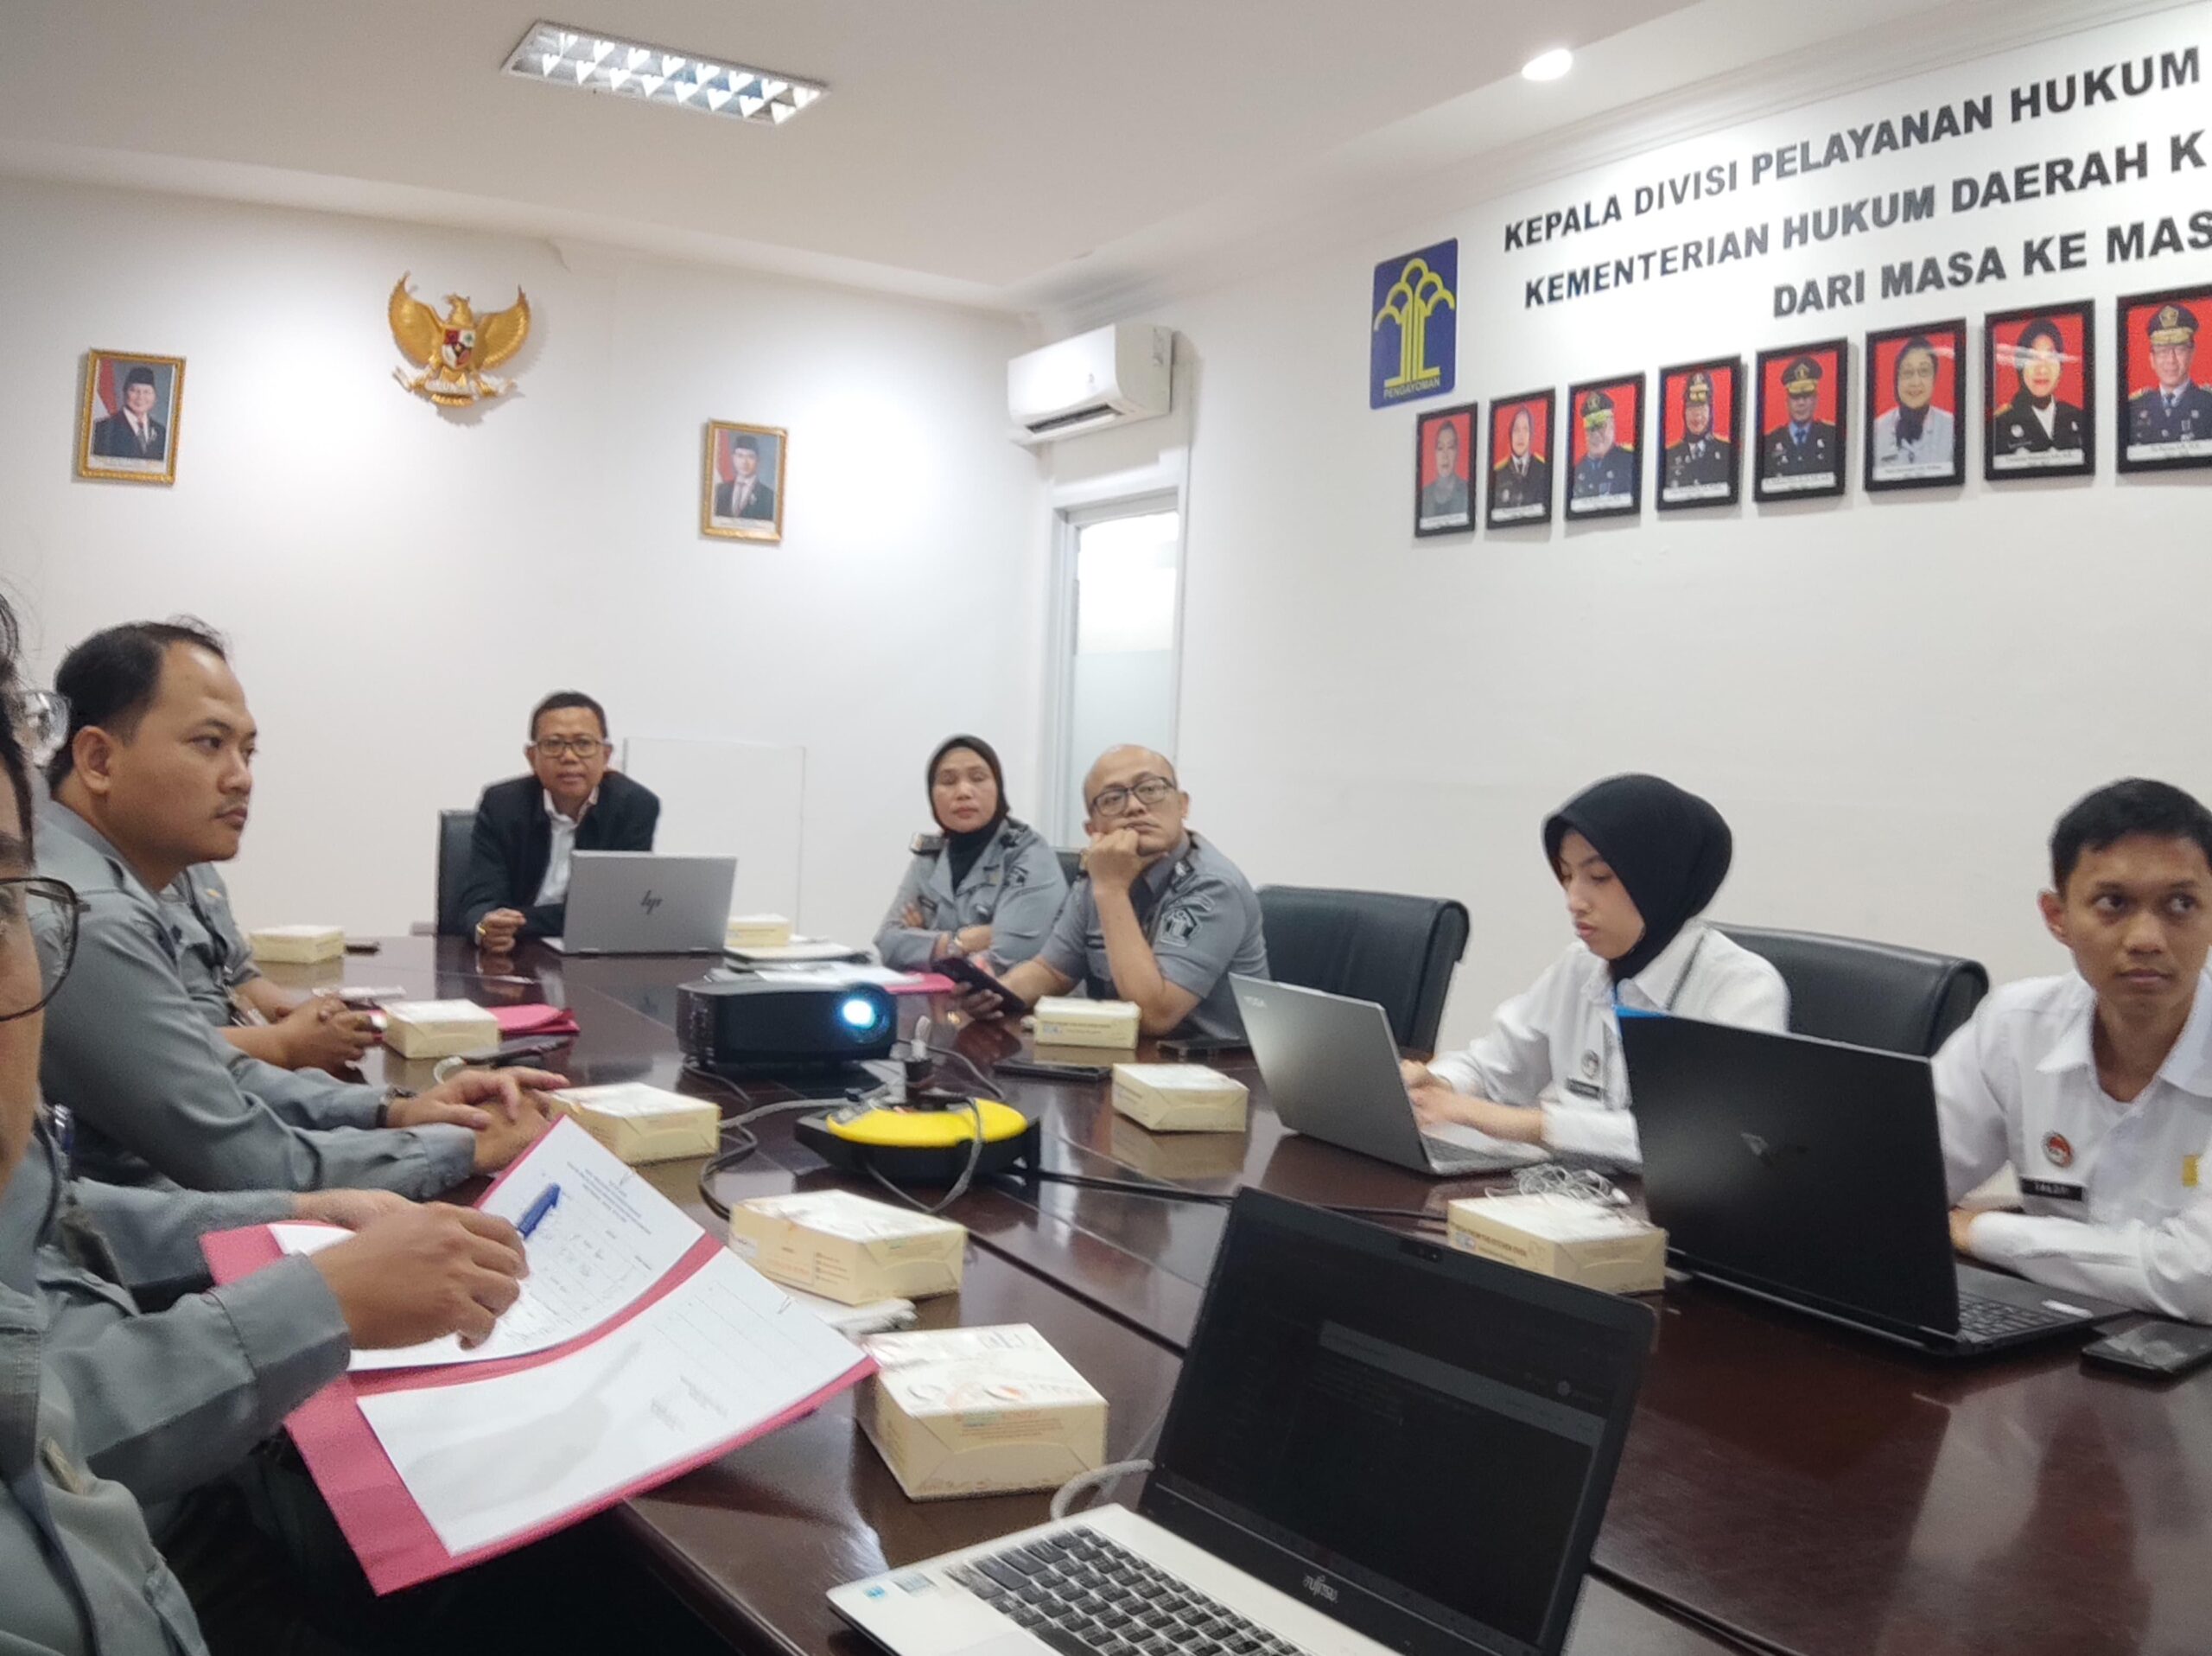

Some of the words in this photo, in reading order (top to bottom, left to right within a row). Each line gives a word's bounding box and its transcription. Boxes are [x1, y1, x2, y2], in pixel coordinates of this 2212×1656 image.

[1503, 194, 1623, 253] KEPALA
[1634, 160, 1738, 217] DIVISI
[1751, 93, 1993, 186] PELAYANAN
[2010, 45, 2200, 124] HUKUM
[1524, 223, 1769, 310] KEMENTERIAN
[1783, 183, 1936, 250] HUKUM
[1951, 140, 2148, 214] DAERAH
[2170, 129, 2207, 174] K
[1773, 269, 1866, 319] DARI
[1880, 245, 2007, 300] MASA
[2023, 230, 2088, 277] KE
[2106, 209, 2212, 264] MAS
[1383, 376, 1441, 399] PENGAYOMAN
